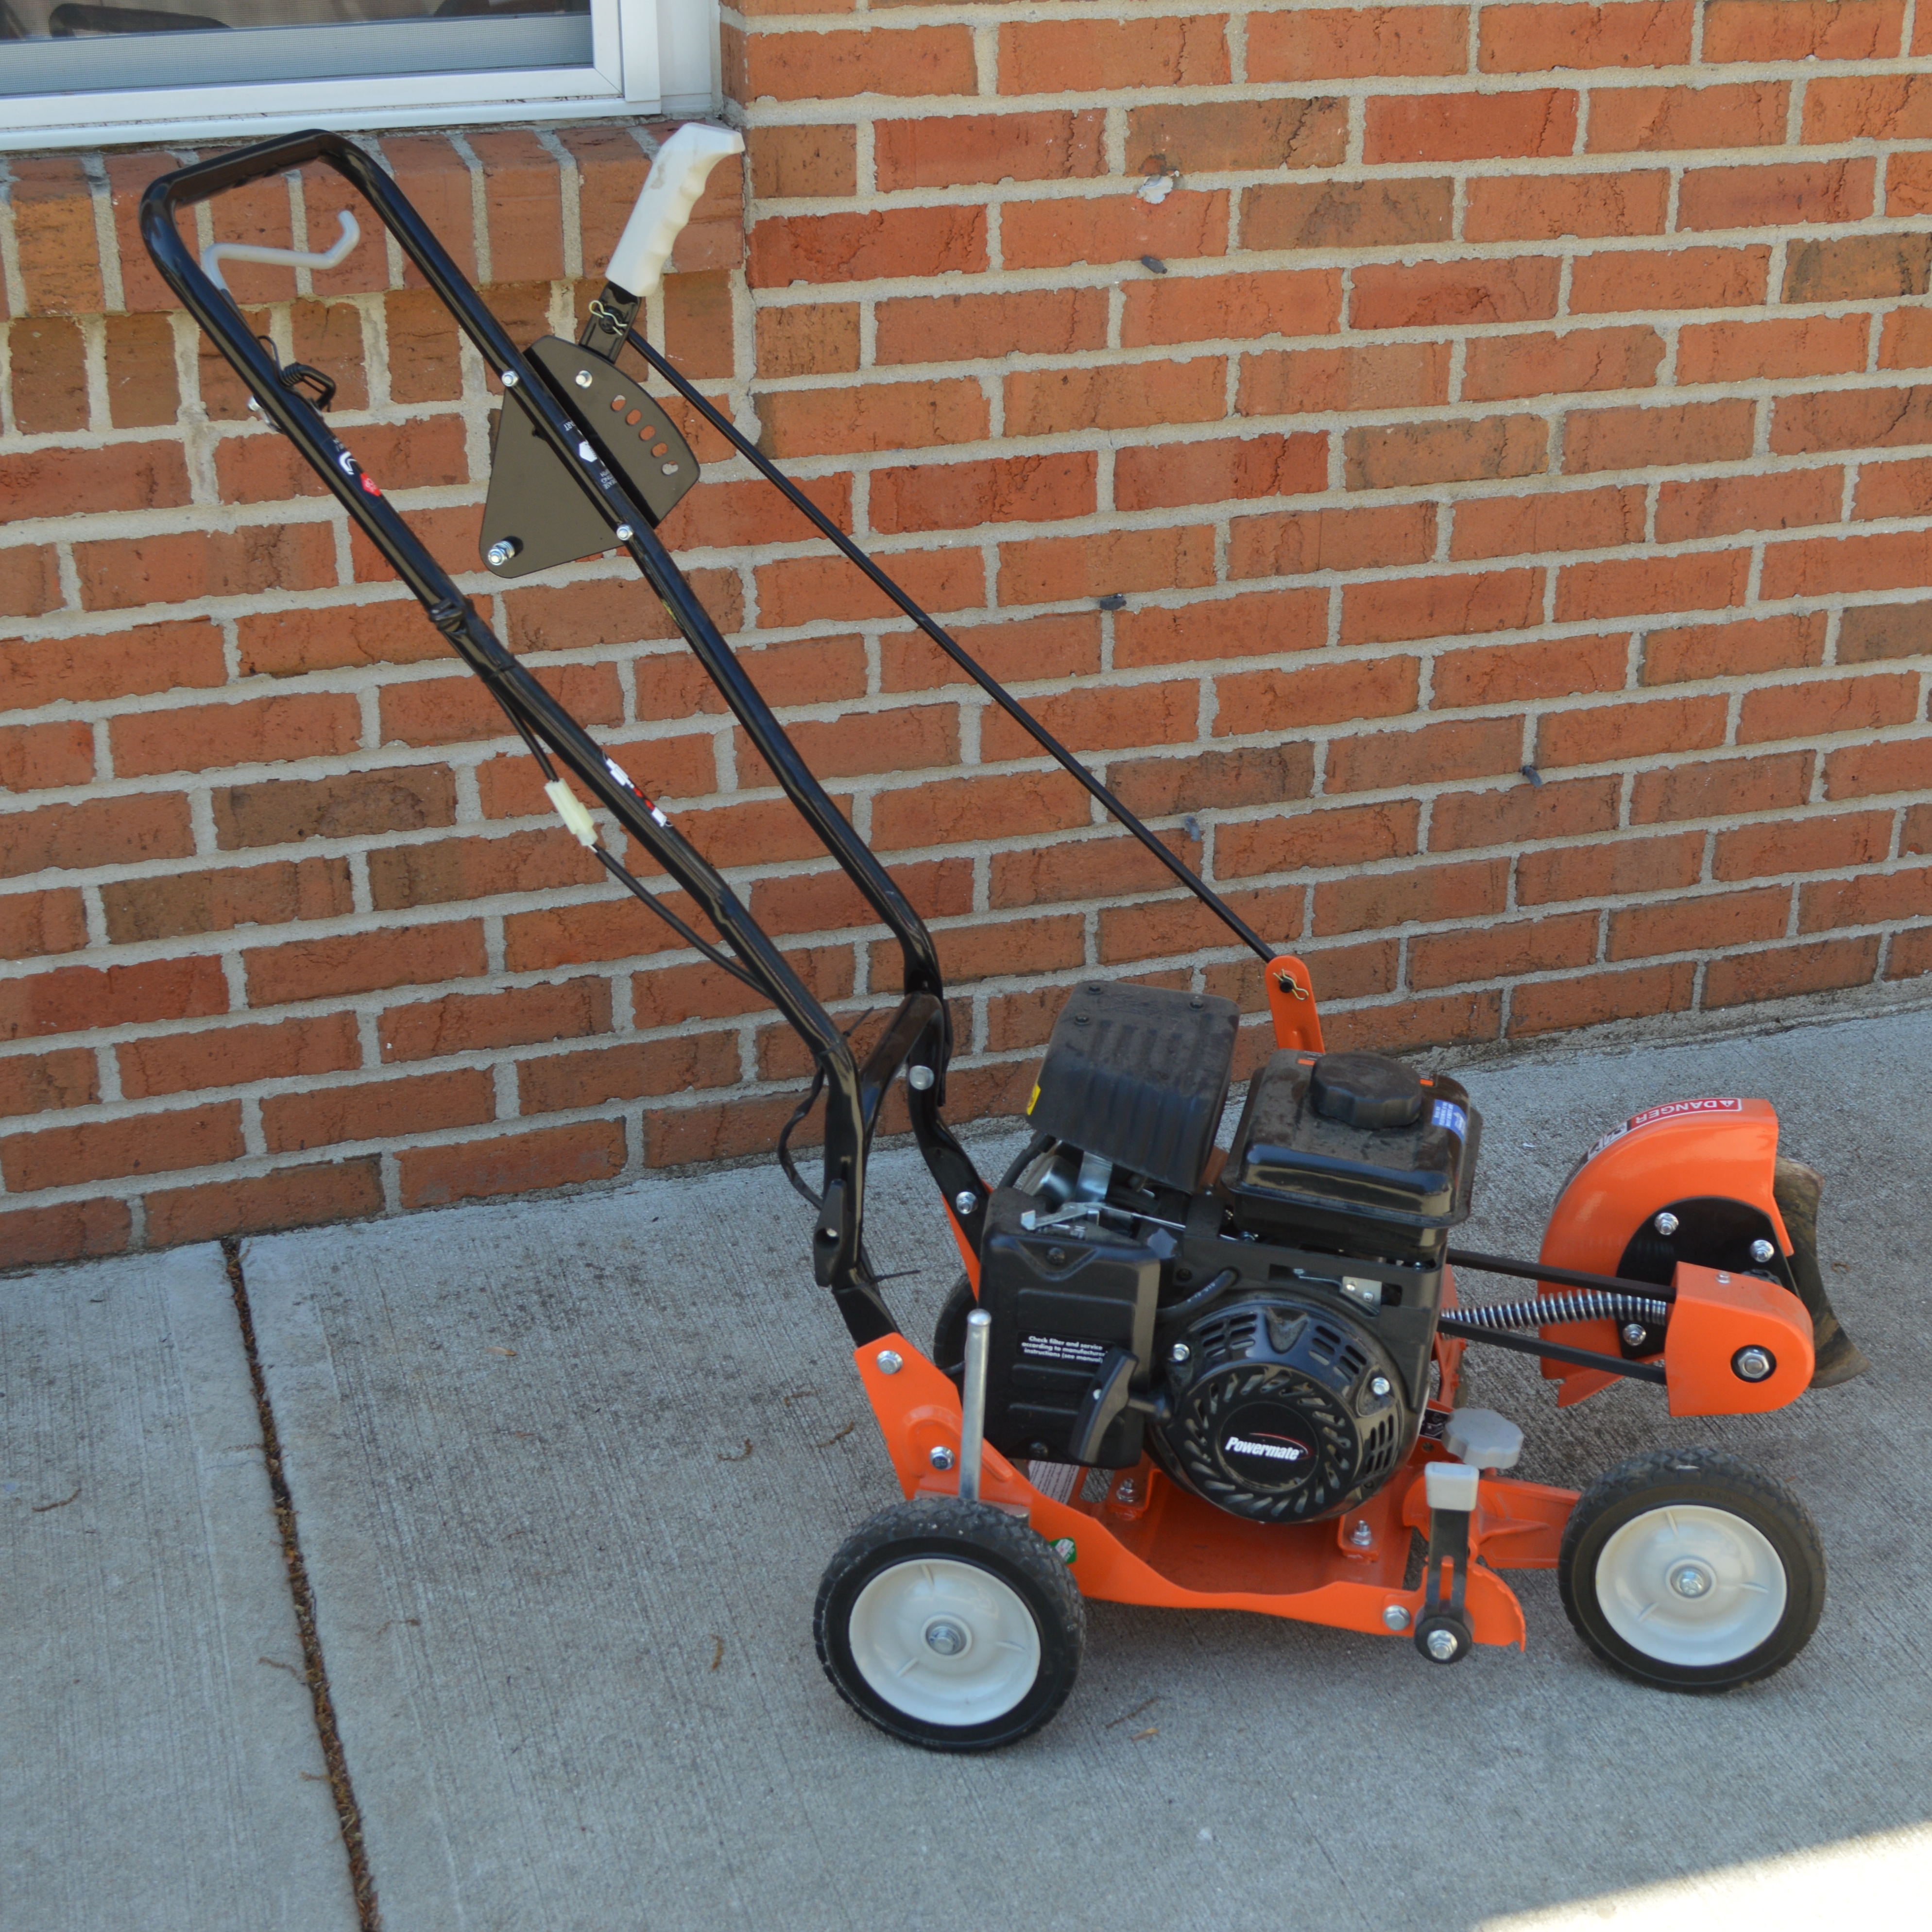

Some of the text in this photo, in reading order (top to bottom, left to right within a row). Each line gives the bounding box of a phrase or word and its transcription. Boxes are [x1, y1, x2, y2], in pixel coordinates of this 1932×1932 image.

[1635, 1100, 1718, 1124] DANGER
[1028, 1335, 1048, 1344] Check
[1049, 1337, 1065, 1346] filter
[1021, 1342, 1053, 1351] according
[1062, 1347, 1108, 1357] manufacturer'
[1024, 1347, 1060, 1357] instructions
[1225, 1436, 1300, 1461] Powermate
